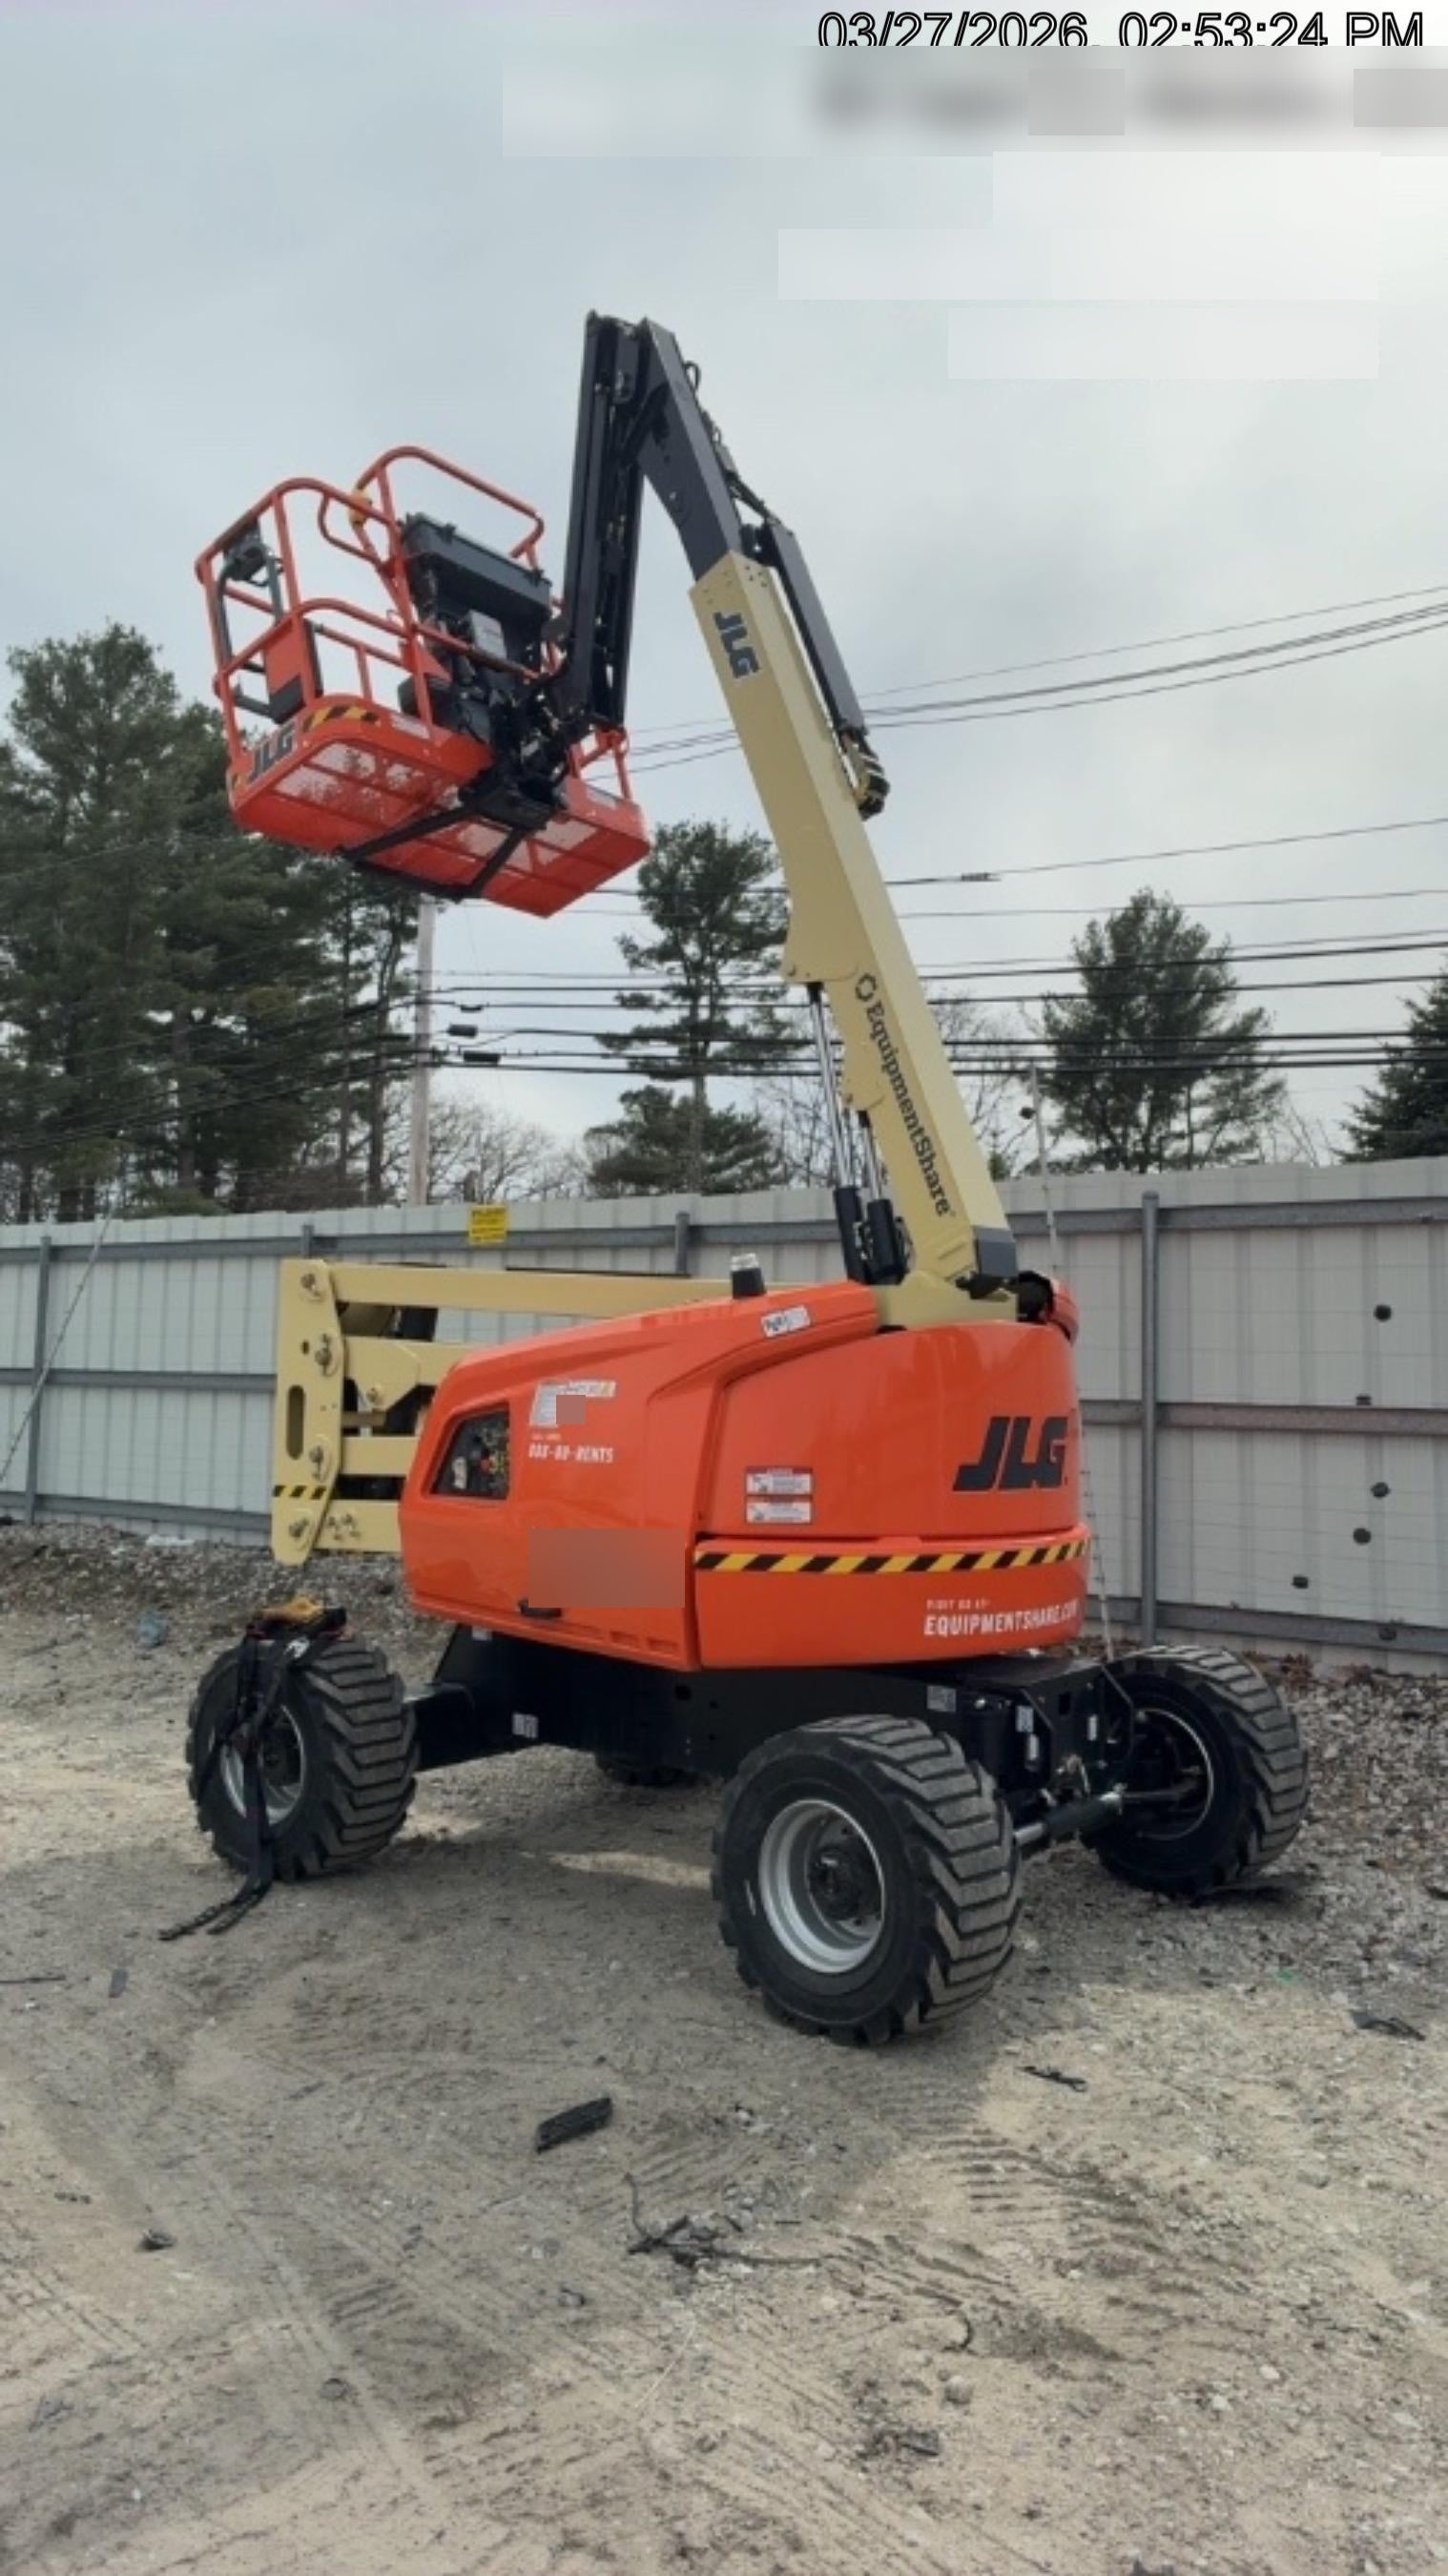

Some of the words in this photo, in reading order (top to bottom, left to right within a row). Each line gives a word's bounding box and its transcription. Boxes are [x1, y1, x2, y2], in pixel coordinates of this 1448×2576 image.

[713, 612, 759, 679] JLG
[248, 718, 299, 783] JLG
[866, 1000, 951, 1216] EquipmentShare
[952, 1416, 1068, 1491] JLG
